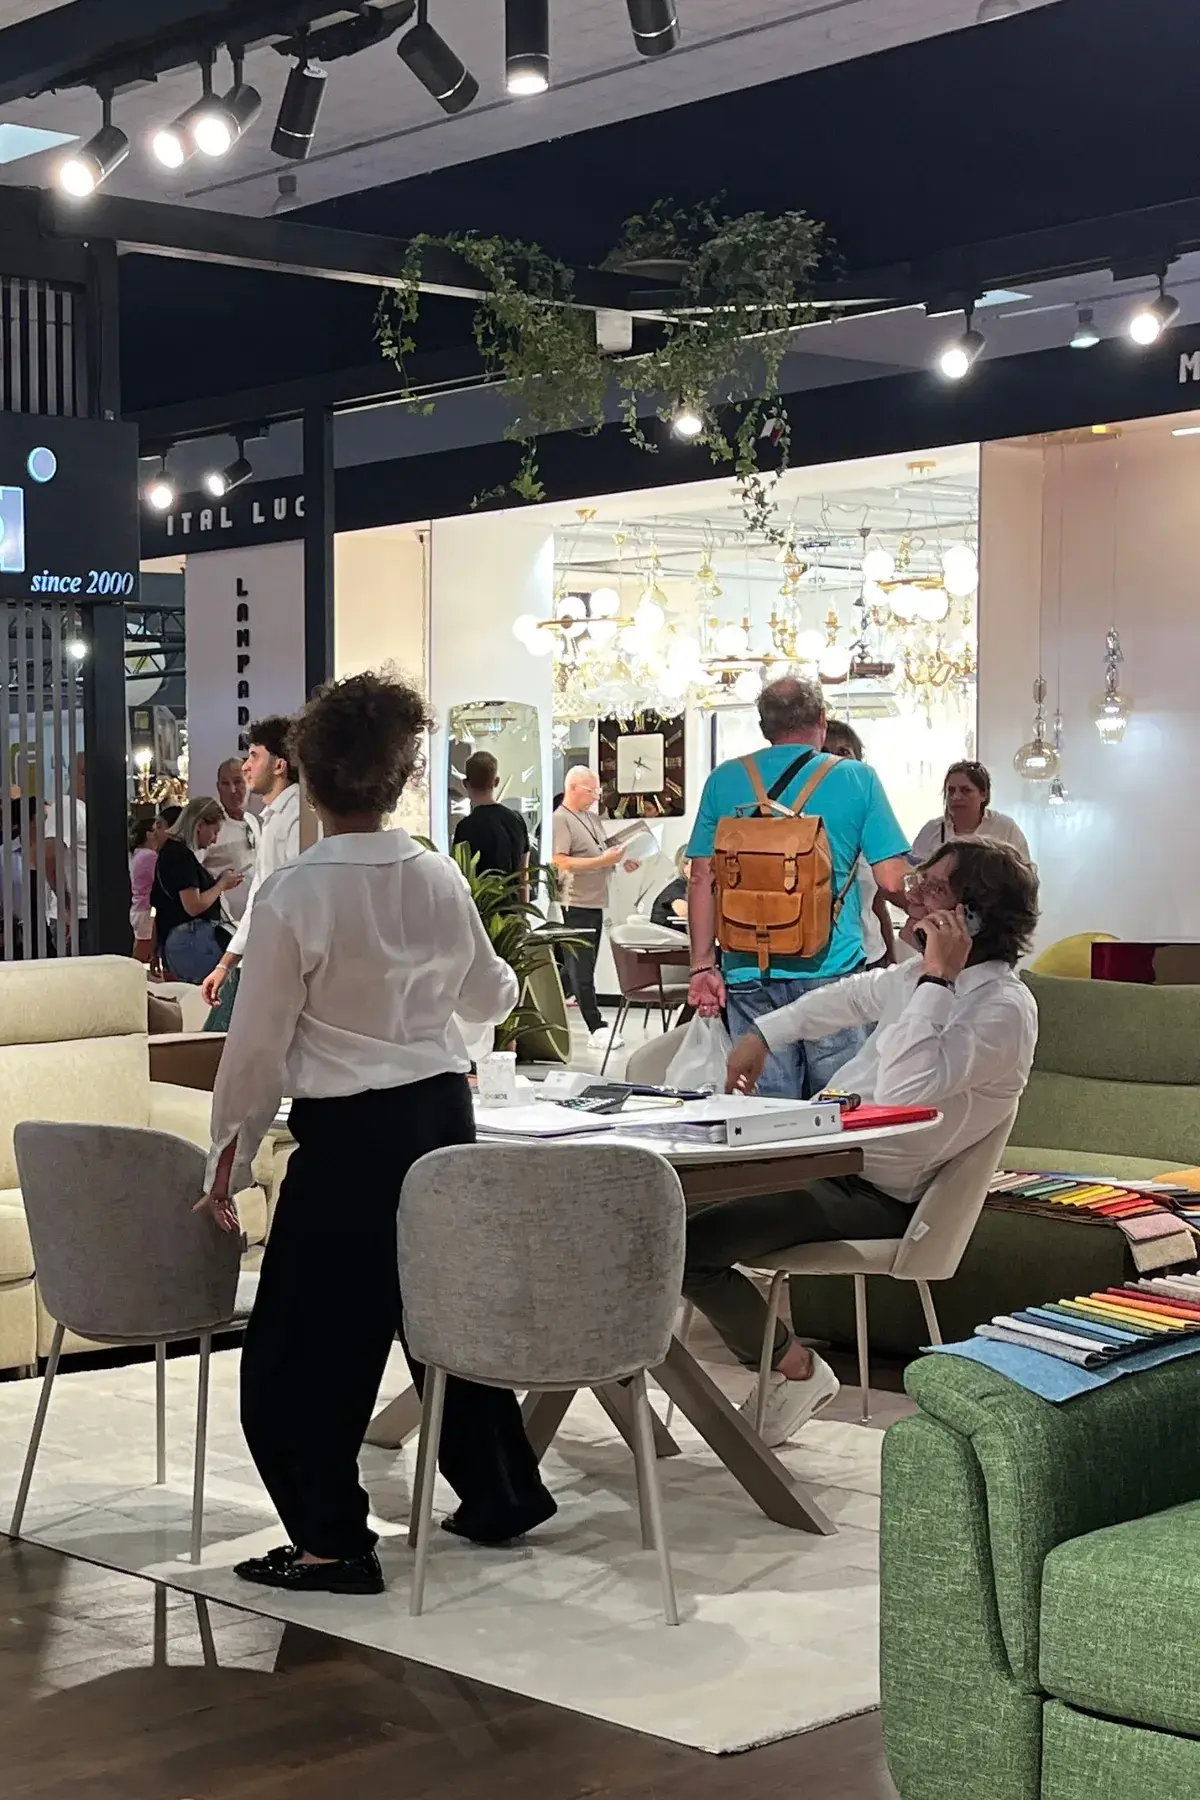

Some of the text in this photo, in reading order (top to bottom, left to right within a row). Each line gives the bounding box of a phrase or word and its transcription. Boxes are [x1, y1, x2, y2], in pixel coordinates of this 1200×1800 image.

[166, 507, 234, 536] ITAL
[30, 569, 134, 595] since 2000
